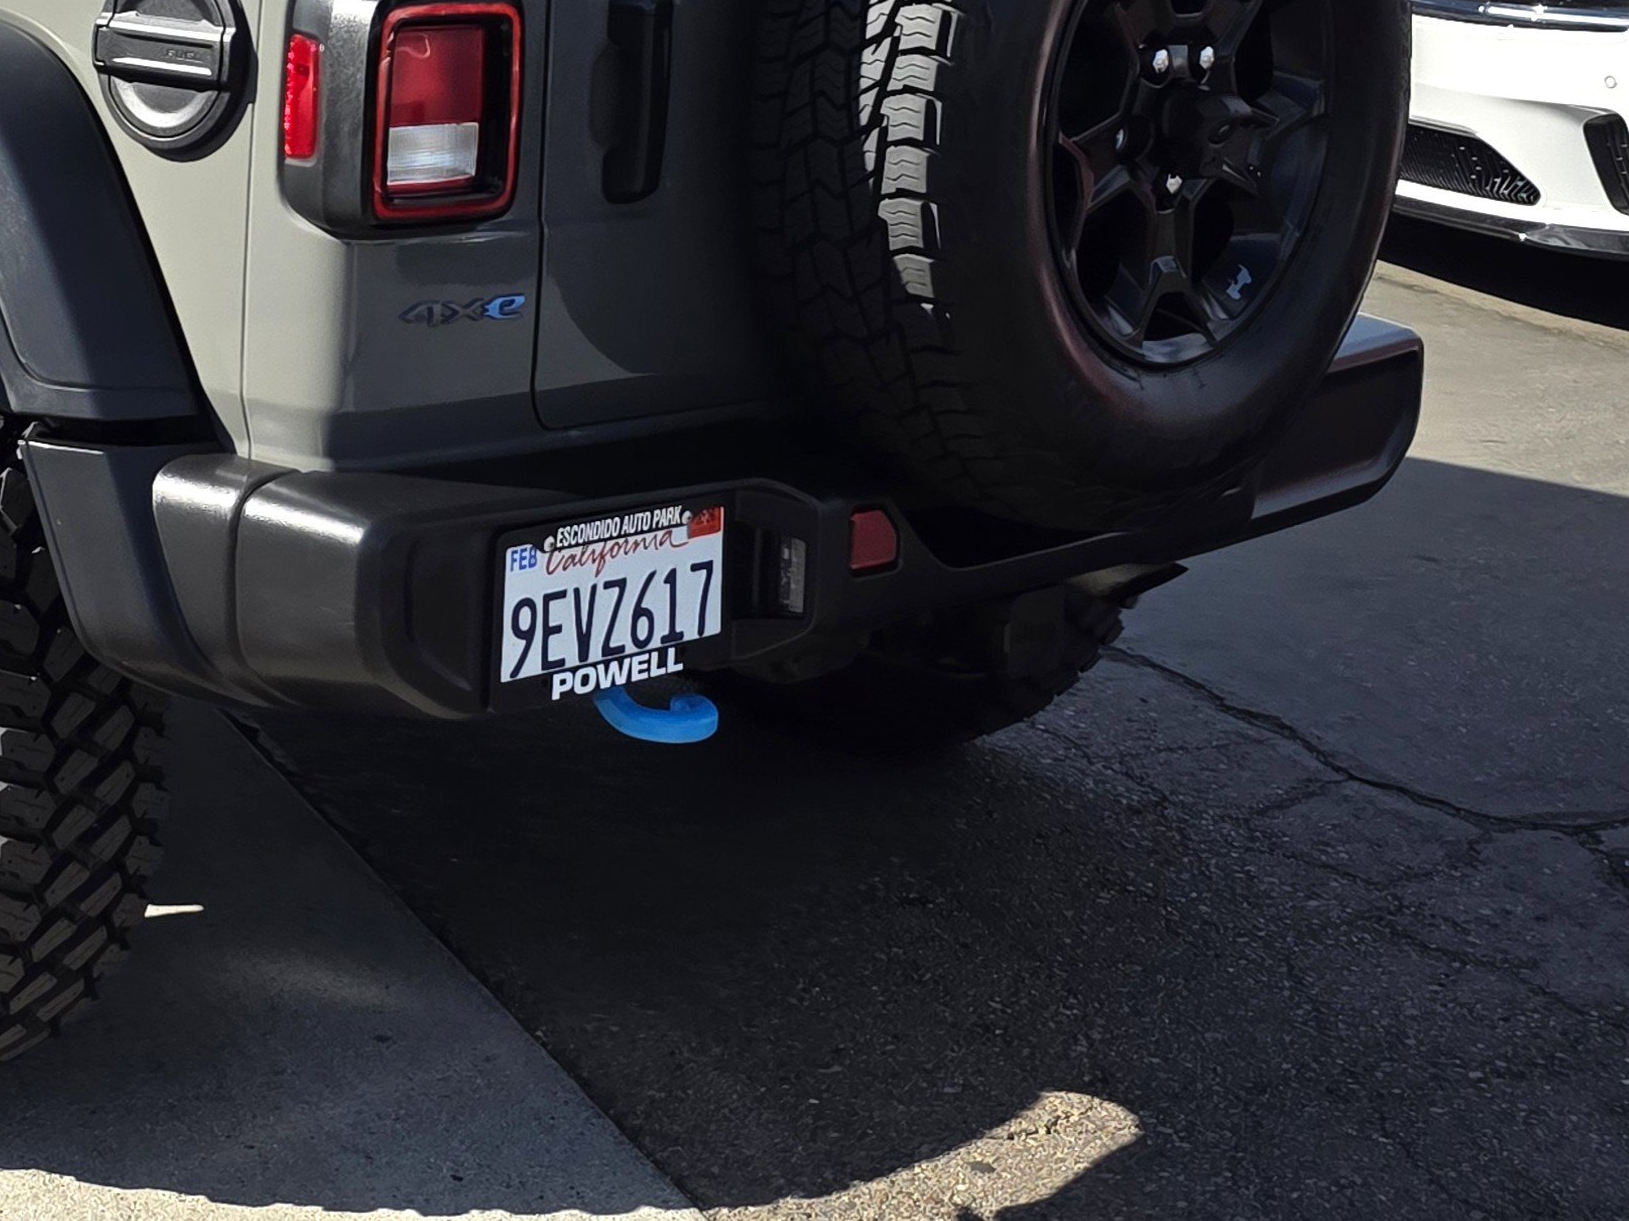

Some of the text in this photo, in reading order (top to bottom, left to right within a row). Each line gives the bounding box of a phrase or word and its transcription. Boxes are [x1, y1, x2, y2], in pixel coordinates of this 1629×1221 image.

[556, 516, 622, 547] ESCONDIDO
[622, 511, 651, 534] AUTO
[653, 505, 682, 527] PARK
[509, 546, 538, 572] FEB
[543, 530, 689, 578] California
[509, 559, 714, 679] 9EVZ617
[551, 647, 684, 701] POWELL
